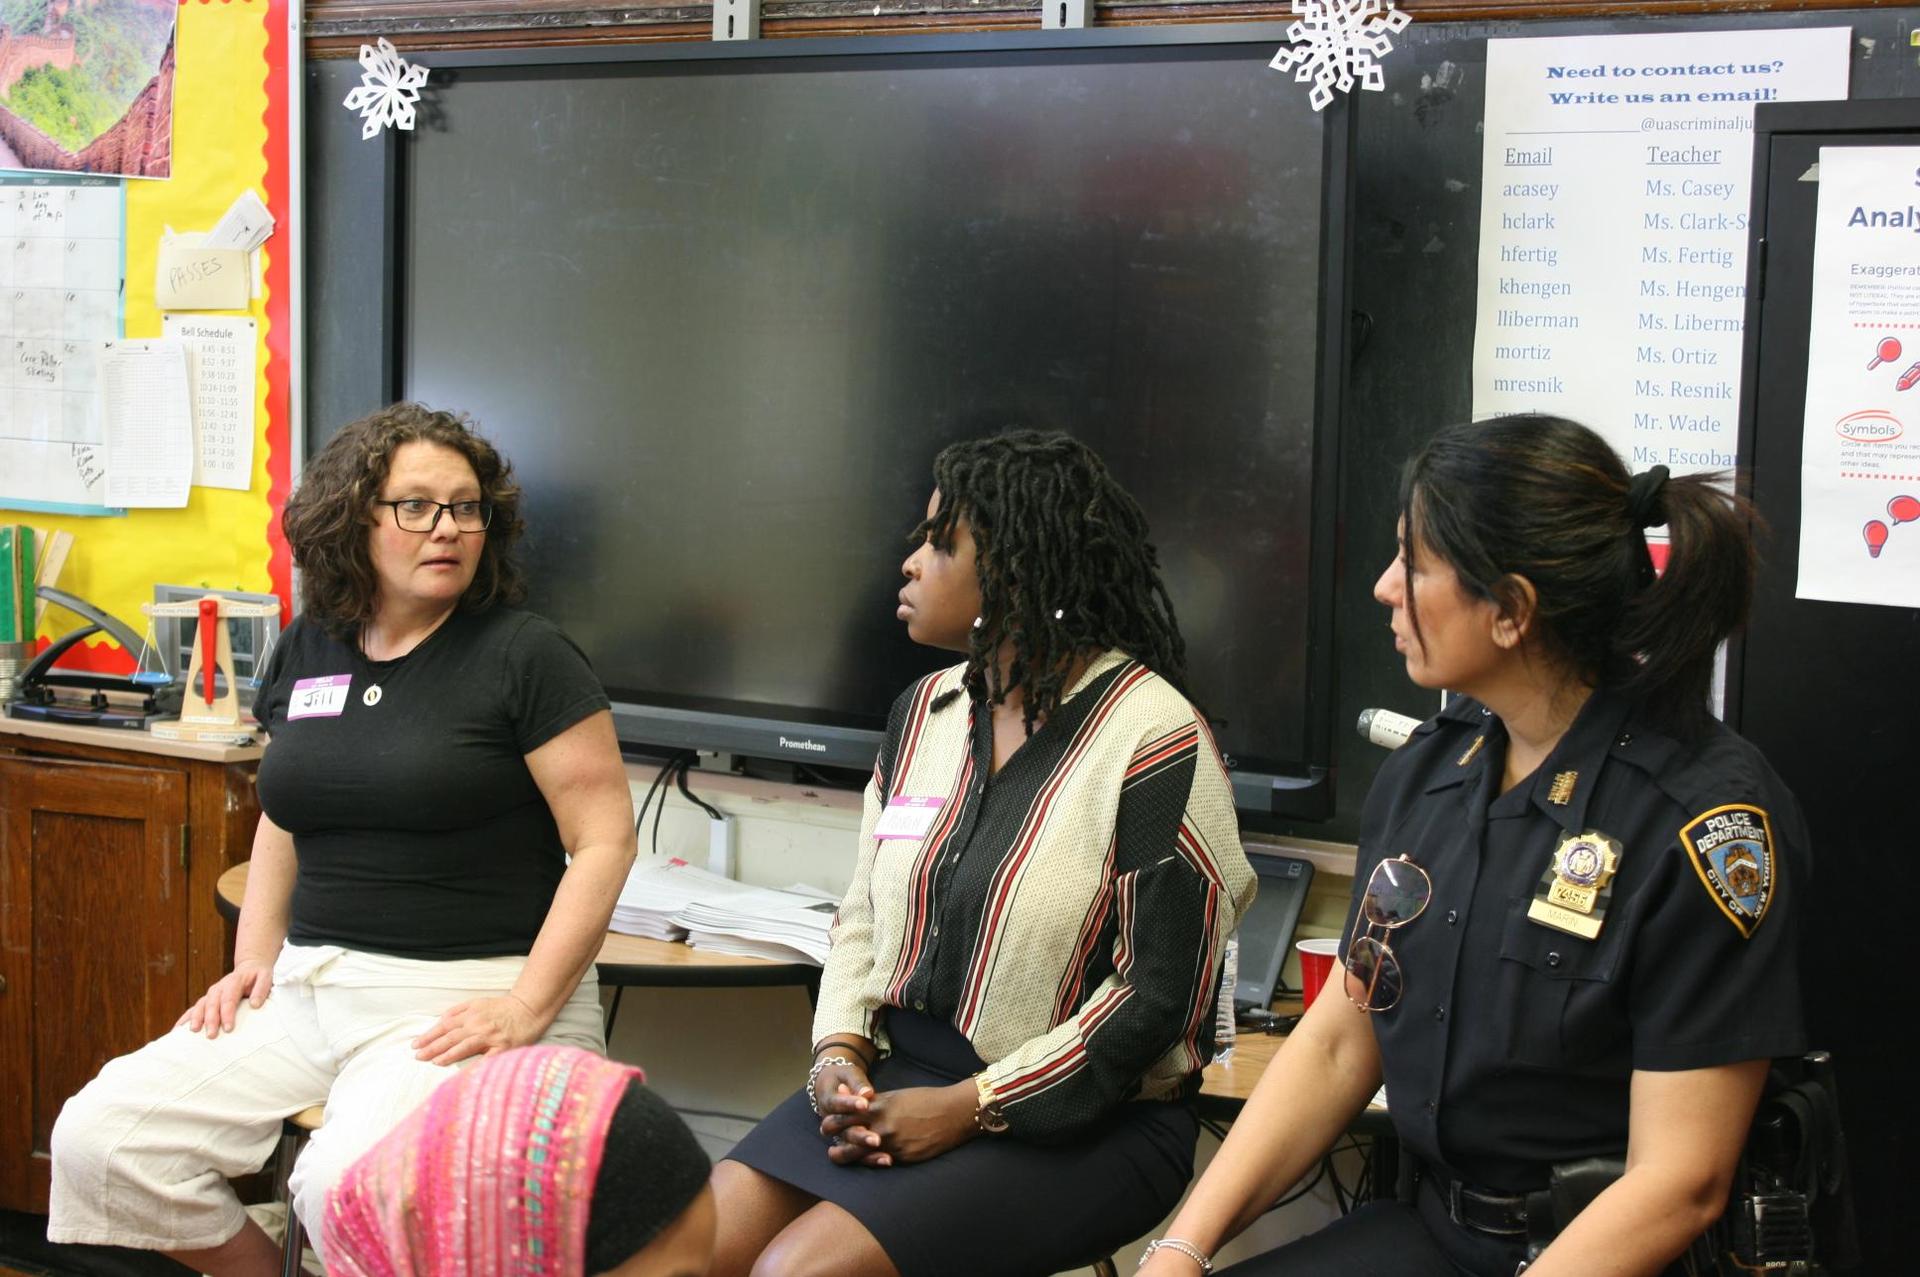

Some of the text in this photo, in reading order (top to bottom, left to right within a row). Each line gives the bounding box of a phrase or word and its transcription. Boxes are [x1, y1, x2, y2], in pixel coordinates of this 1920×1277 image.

[1546, 60, 1784, 78] Need to contact us?
[1549, 88, 1778, 104] Write us an email!
[1504, 146, 1552, 166] Email
[1647, 146, 1721, 165] Teacher
[1502, 182, 1559, 200] acasey
[1646, 180, 1735, 200] Ms. Casey
[1502, 213, 1555, 229] hclark
[1643, 213, 1673, 230] Ms.
[1501, 246, 1557, 267] hfertig
[1642, 247, 1733, 268] Ms. Fertig
[169, 257, 223, 294] PASSES
[1499, 278, 1571, 299] khengen
[1639, 280, 1670, 297] Ms.
[1497, 310, 1579, 328] lliberman
[1638, 313, 1668, 331] Ms.
[181, 326, 233, 339] Bell Schedule
[1495, 344, 1551, 361] mortiz
[1636, 347, 1718, 365] Ms. Ortiz
[1493, 376, 1563, 394] mresnik
[1635, 380, 1732, 399] Ms. Resnik
[1633, 413, 1721, 432] Mr. Wade
[1842, 423, 1896, 437] Symbols
[1633, 447, 1662, 464] Ms.
[304, 689, 333, 708] Jill
[779, 736, 826, 752] Promethean
[1704, 812, 1752, 833] POLICE
[1695, 825, 1765, 855] DEPARTMENT
[1706, 868, 1729, 899] CITY
